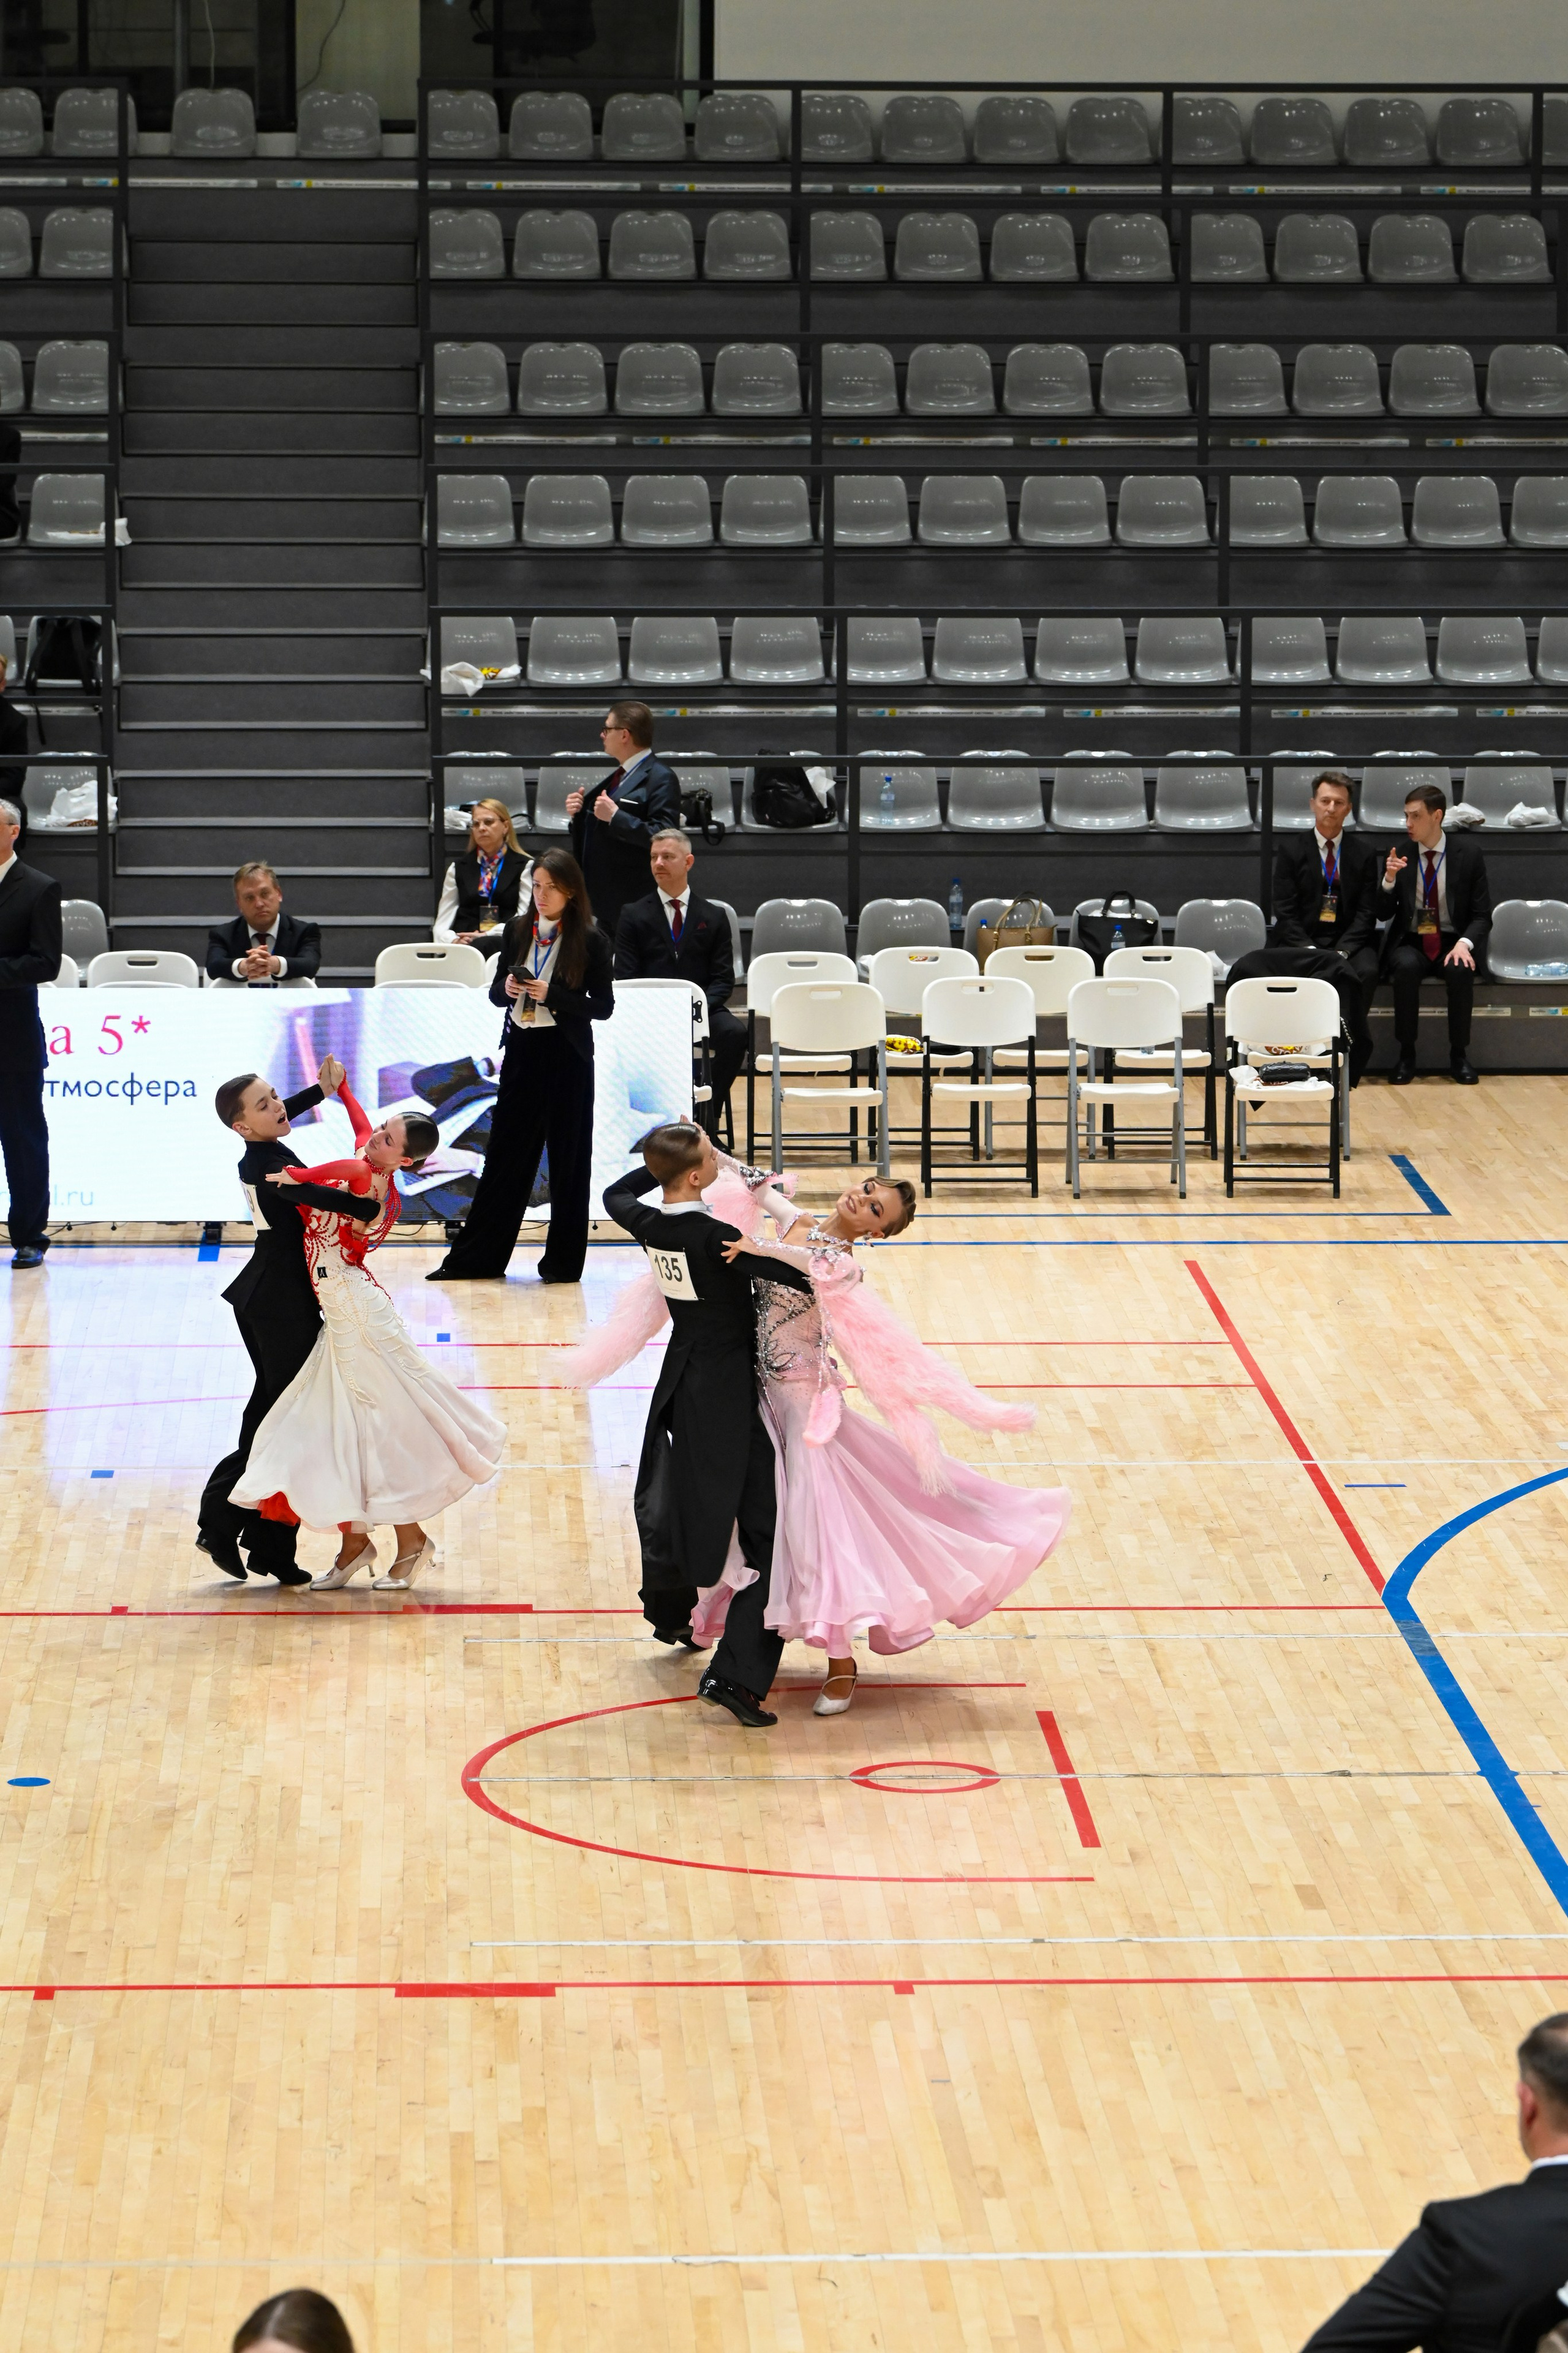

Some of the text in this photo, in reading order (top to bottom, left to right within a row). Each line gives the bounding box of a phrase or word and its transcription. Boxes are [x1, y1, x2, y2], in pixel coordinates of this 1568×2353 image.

[49, 1025, 74, 1055] а
[45, 1072, 197, 1105] тмосфера
[654, 1254, 683, 1282] 135
